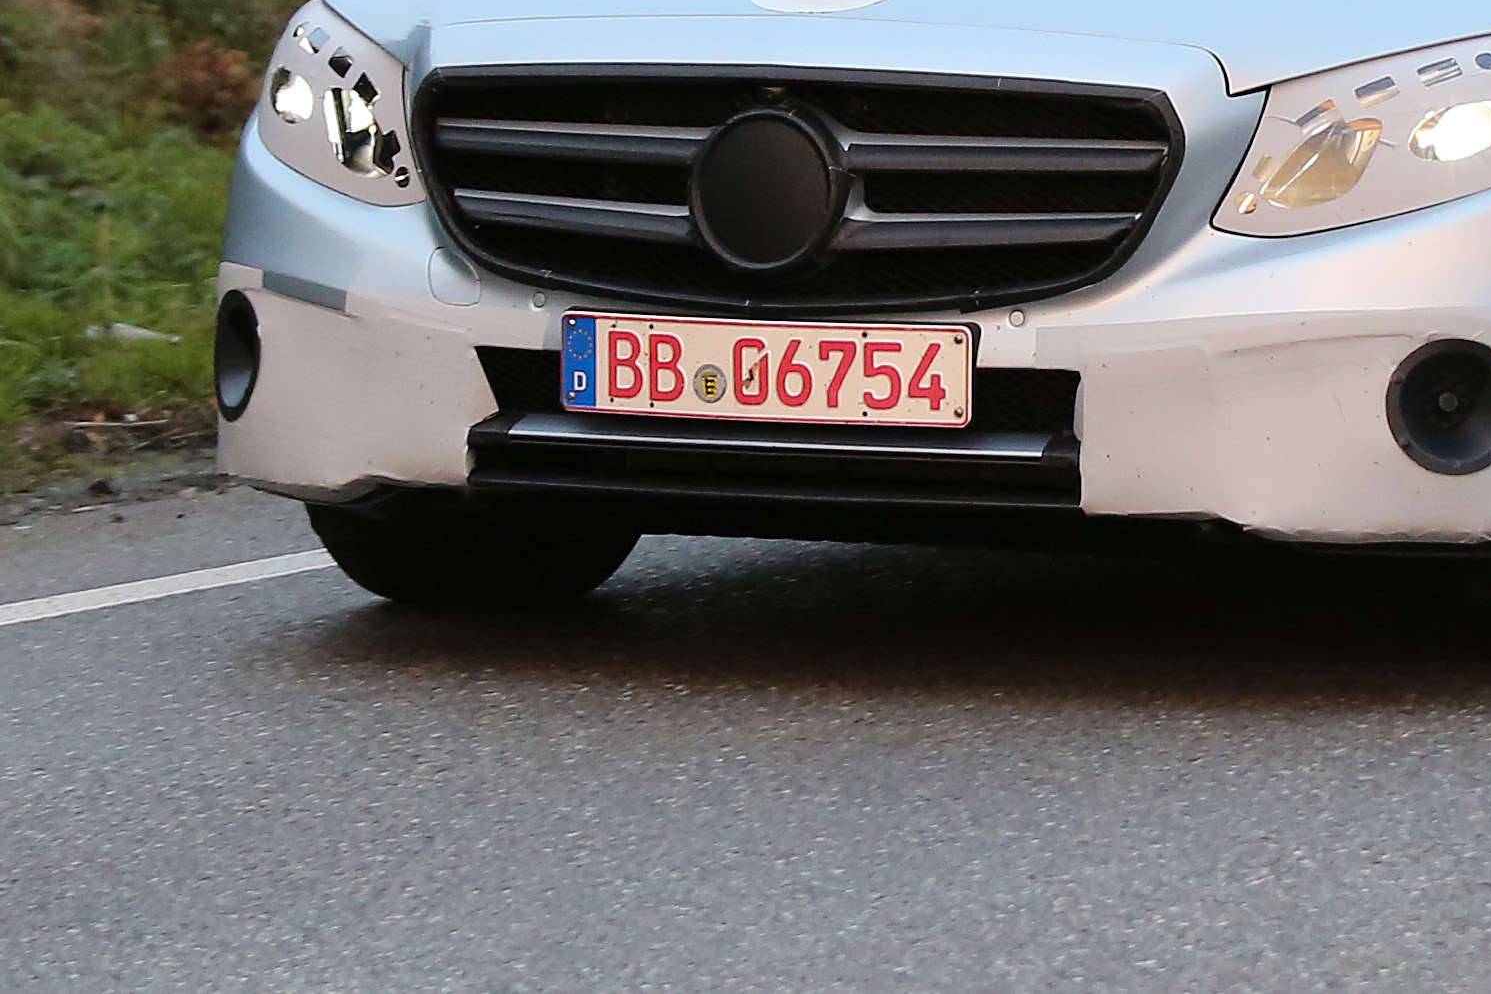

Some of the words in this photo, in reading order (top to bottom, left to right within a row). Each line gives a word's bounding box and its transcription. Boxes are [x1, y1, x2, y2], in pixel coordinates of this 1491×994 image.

[573, 370, 587, 391] D
[608, 330, 686, 402] BB
[732, 336, 947, 411] 06754
